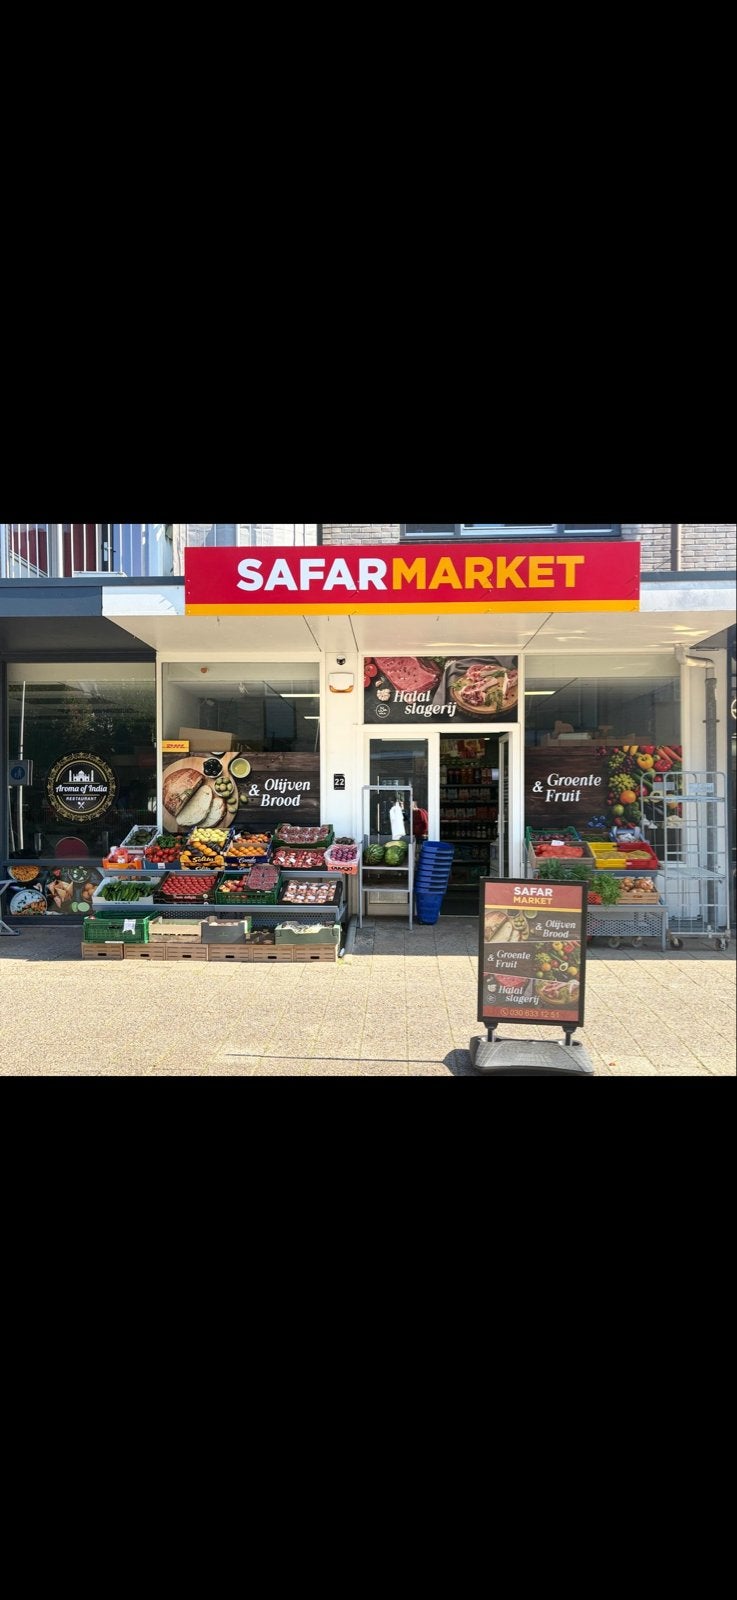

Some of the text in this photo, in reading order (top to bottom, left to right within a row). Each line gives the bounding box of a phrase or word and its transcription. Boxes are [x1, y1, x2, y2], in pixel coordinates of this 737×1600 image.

[393, 690, 431, 703] Halal
[404, 702, 457, 717] slagerij
[249, 778, 311, 797] & Olijven
[532, 773, 602, 793] & Groente
[55, 784, 108, 794] Aroma of India
[260, 794, 301, 807] Brood
[545, 789, 581, 802] Fruit
[513, 886, 553, 896] SAFAR
[513, 896, 553, 905] MARKET
[535, 919, 576, 931] & Olijven
[542, 929, 570, 938] Brood
[487, 949, 531, 962] & Groente
[495, 960, 518, 969] Fruit
[498, 985, 524, 995] Halal
[505, 995, 541, 1006] slagerij
[509, 1009, 523, 1017] 030
